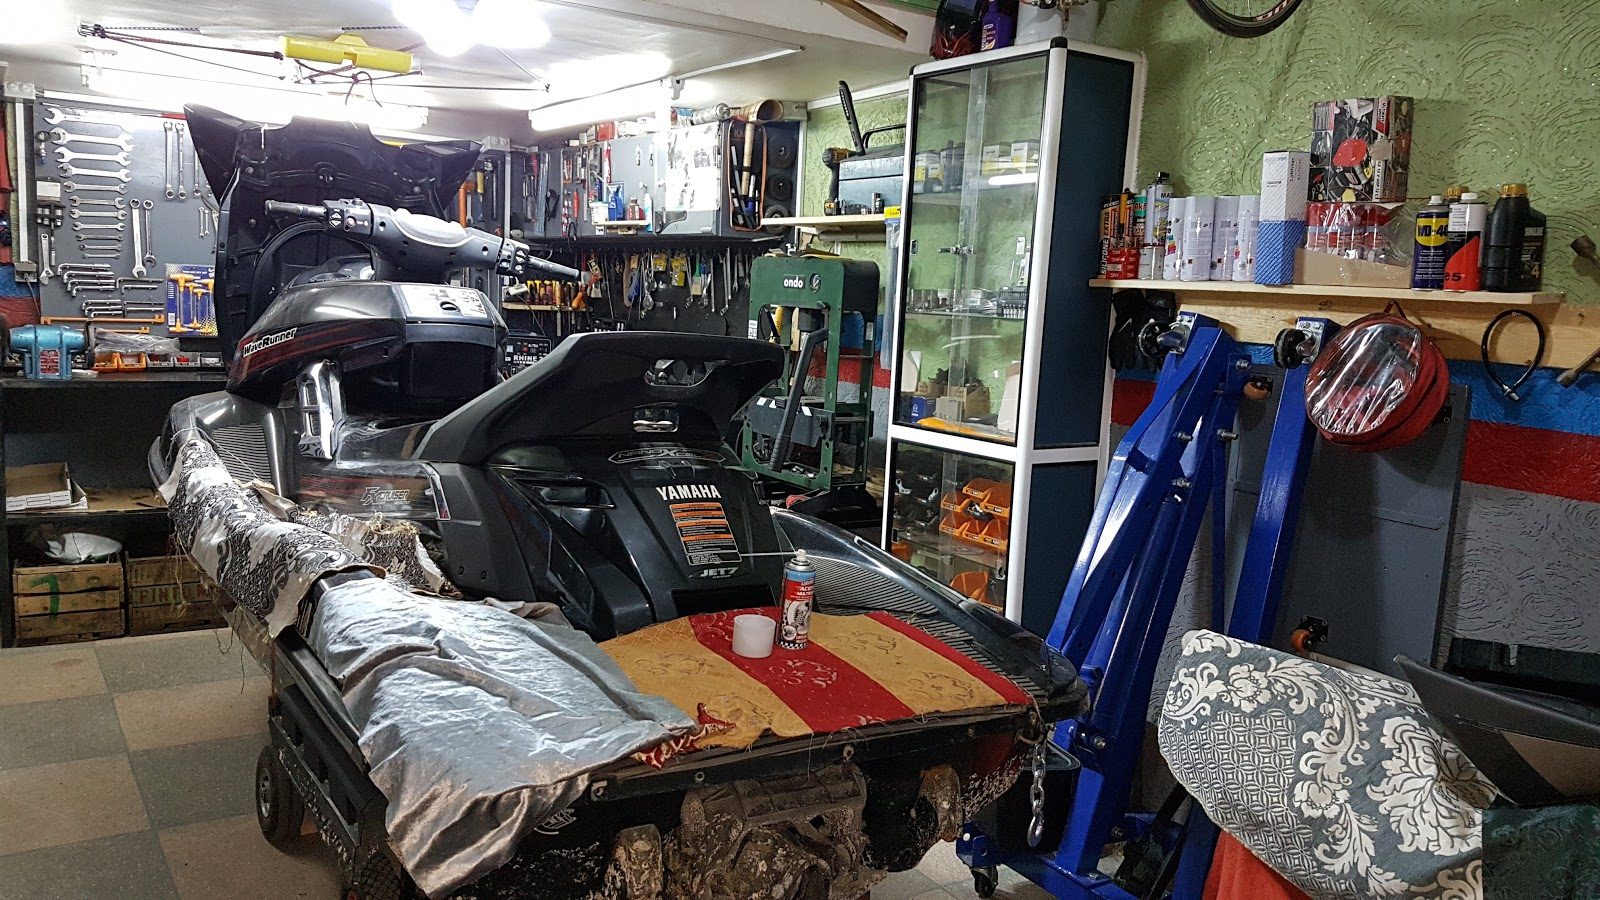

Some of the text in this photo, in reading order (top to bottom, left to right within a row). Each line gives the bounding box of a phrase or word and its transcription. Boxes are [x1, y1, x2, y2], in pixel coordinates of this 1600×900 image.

[1100, 237, 1109, 275] SILICONE
[783, 276, 804, 288] ondo
[243, 327, 297, 358] WaveRunner
[656, 485, 722, 500] YAMAHA
